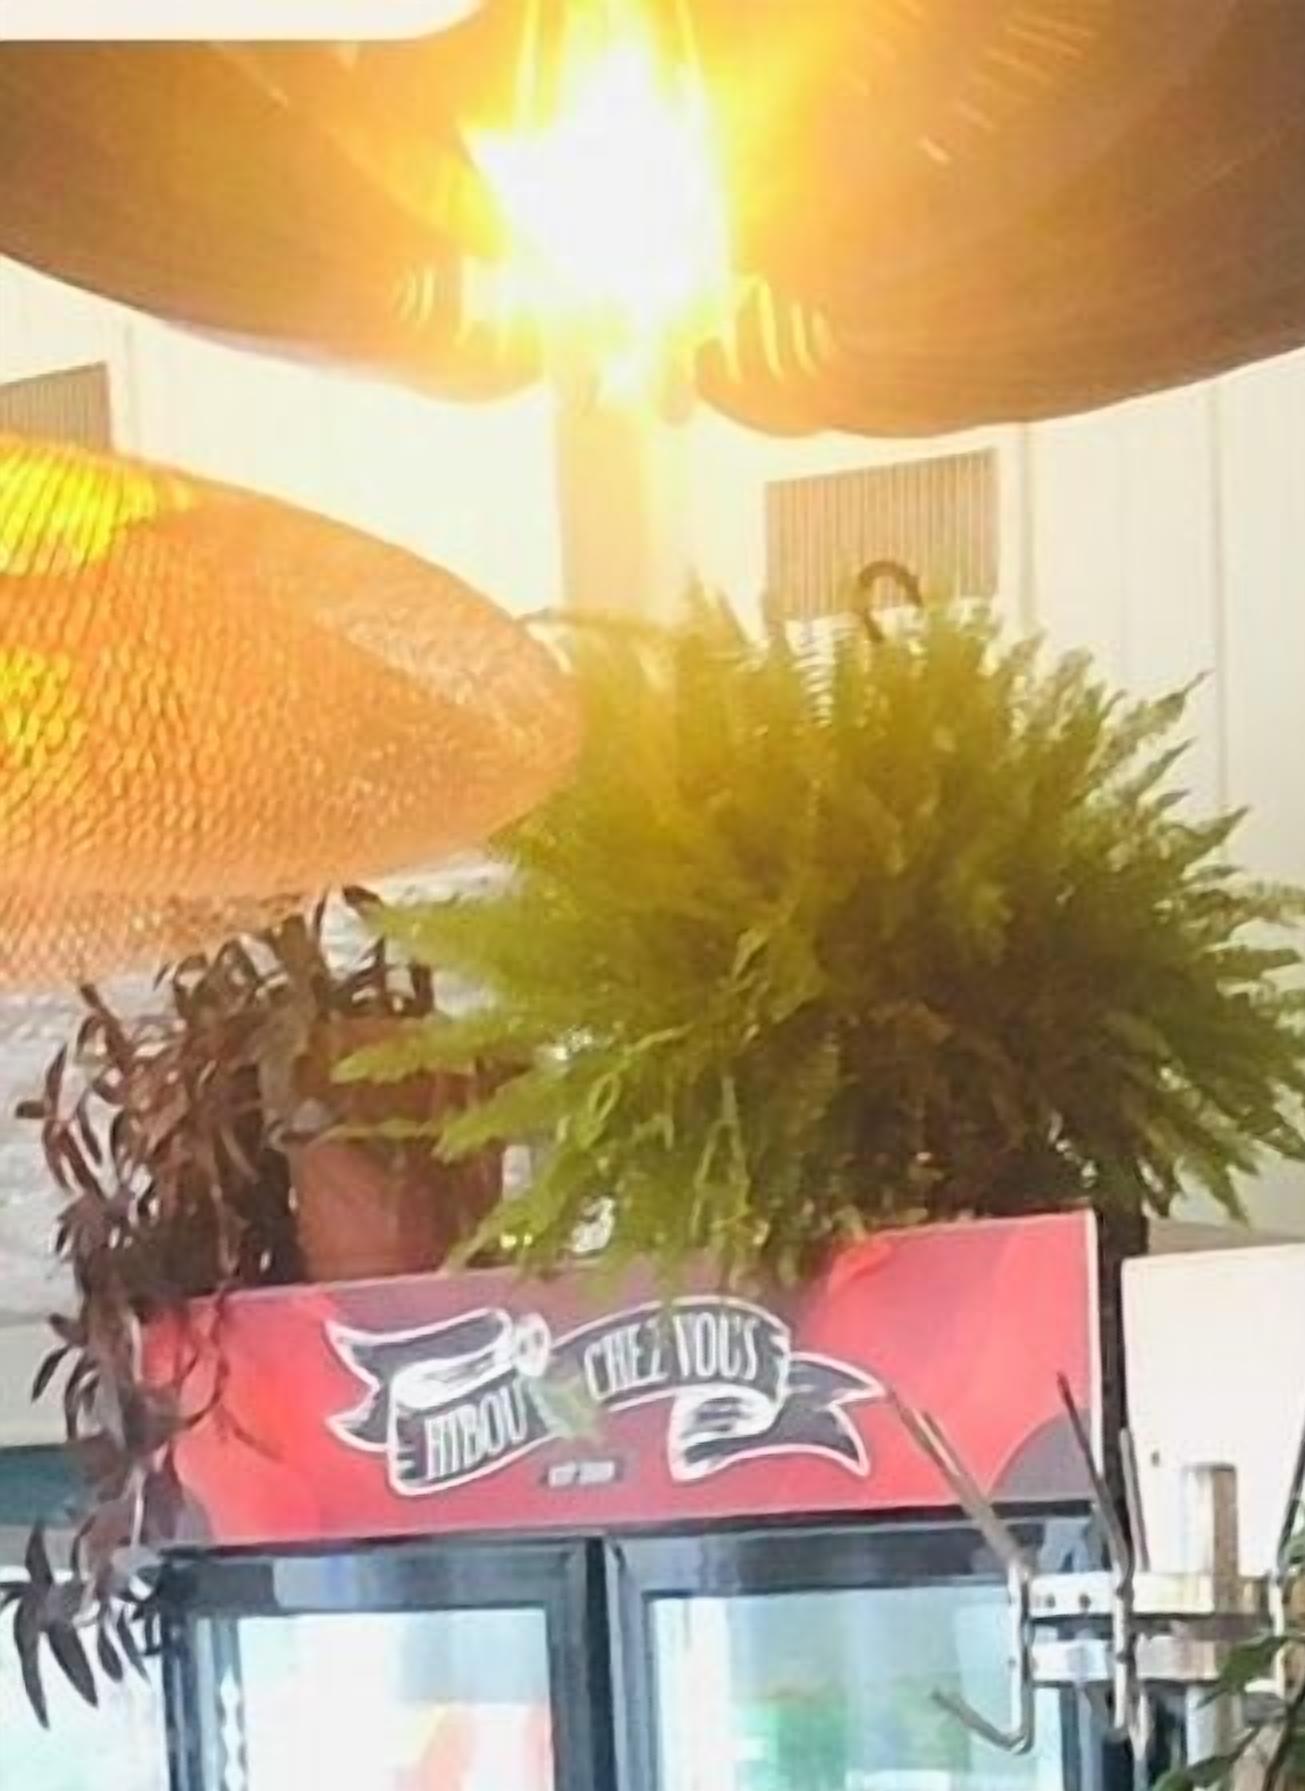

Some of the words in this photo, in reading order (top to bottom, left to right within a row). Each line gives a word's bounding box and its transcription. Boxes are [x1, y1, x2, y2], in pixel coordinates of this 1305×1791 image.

[585, 1317, 668, 1402] CHEZ
[674, 1311, 761, 1382] VOUS
[424, 1372, 528, 1481] HIBOU
